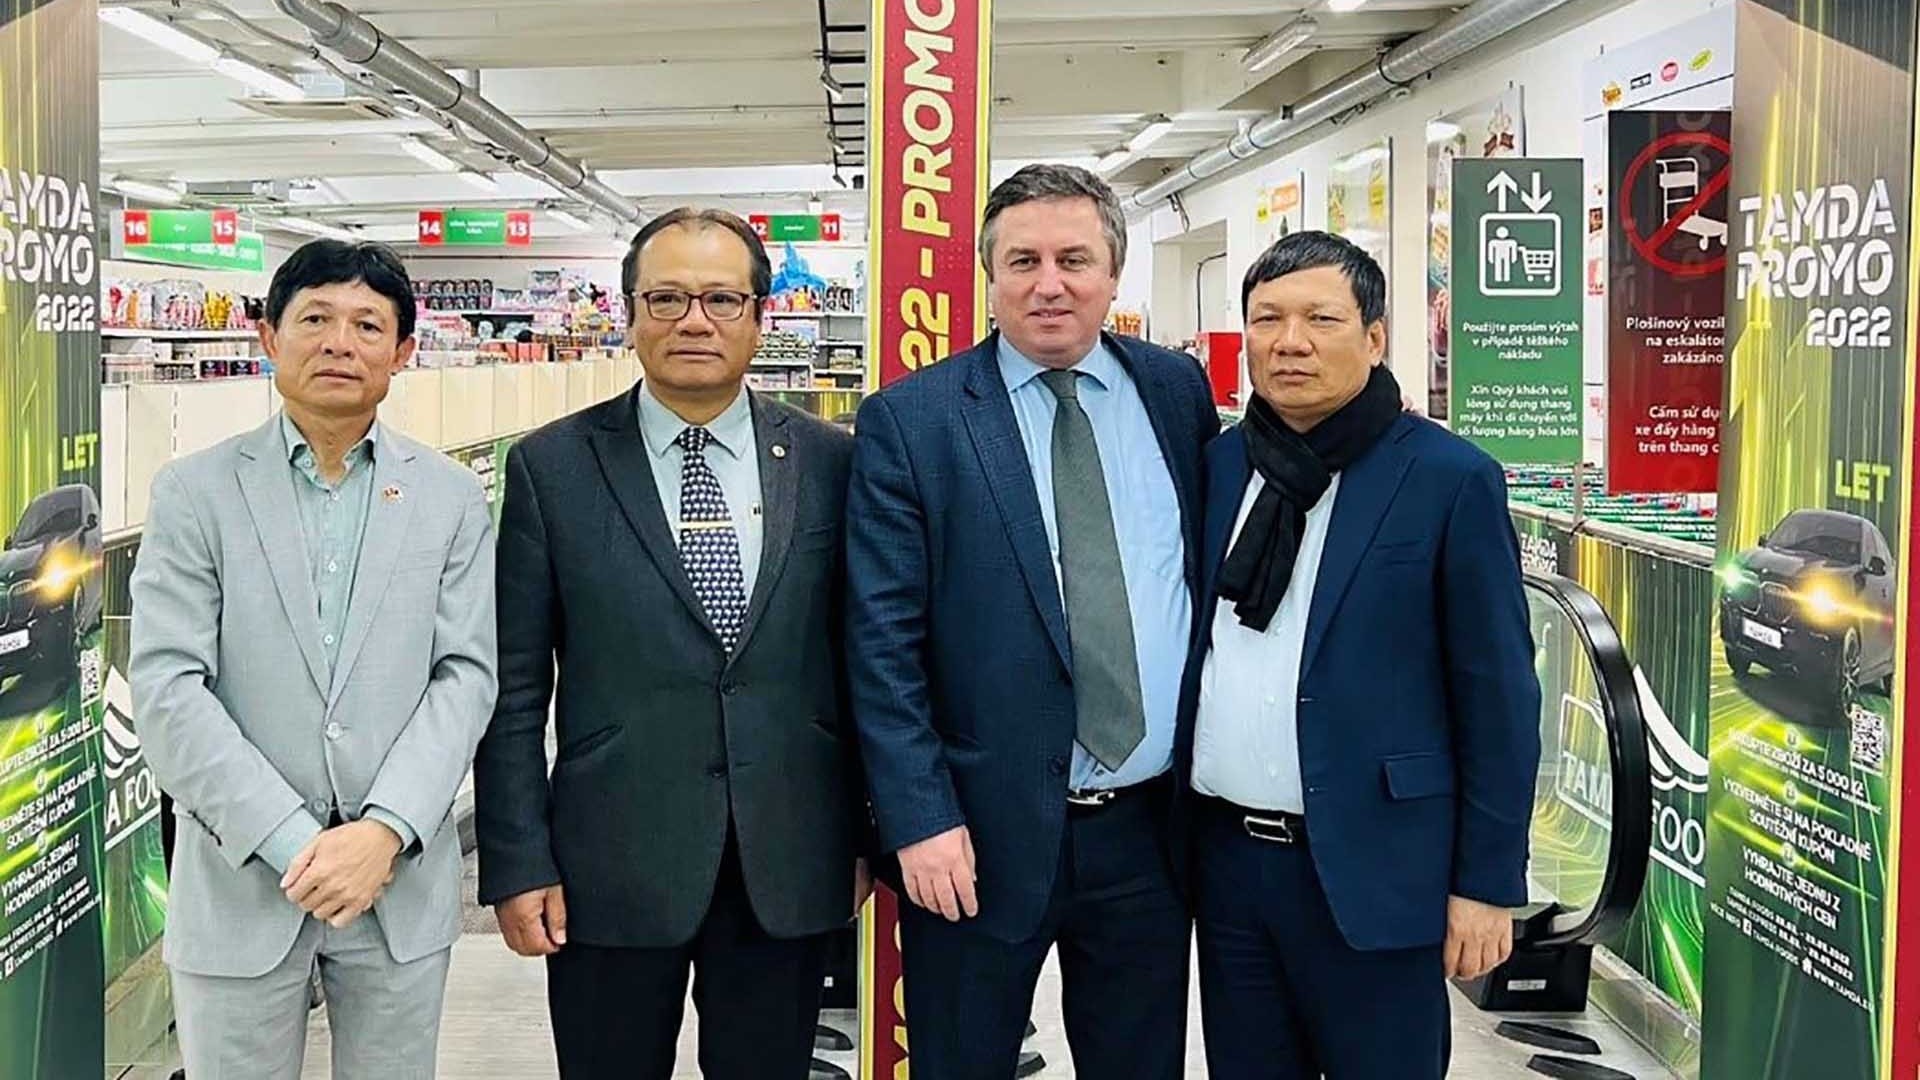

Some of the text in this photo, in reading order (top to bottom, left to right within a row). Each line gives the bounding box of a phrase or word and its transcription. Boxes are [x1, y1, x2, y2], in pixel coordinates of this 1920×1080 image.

[1739, 179, 1896, 247] TAMDA
[126, 221, 146, 236] 16
[215, 221, 234, 236] 15
[421, 221, 441, 236] 14
[509, 221, 528, 237] 13
[823, 221, 838, 235] 11
[1736, 239, 1894, 300] PROMO
[37, 293, 95, 332] 2022
[1549, 320, 1579, 334] výtah
[1626, 316, 1691, 332] Plošinový
[1806, 306, 1892, 348] 2022
[1645, 337, 1662, 347] na
[1662, 350, 1725, 364] zakázáno
[1471, 384, 1489, 395] Xin
[1540, 399, 1572, 411] thang
[1635, 426, 1651, 436] xe
[1682, 423, 1716, 439] hàng
[62, 433, 97, 471] LET
[1638, 440, 1667, 453] trên
[1670, 440, 1709, 456] thang
[1835, 461, 1891, 503] LET
